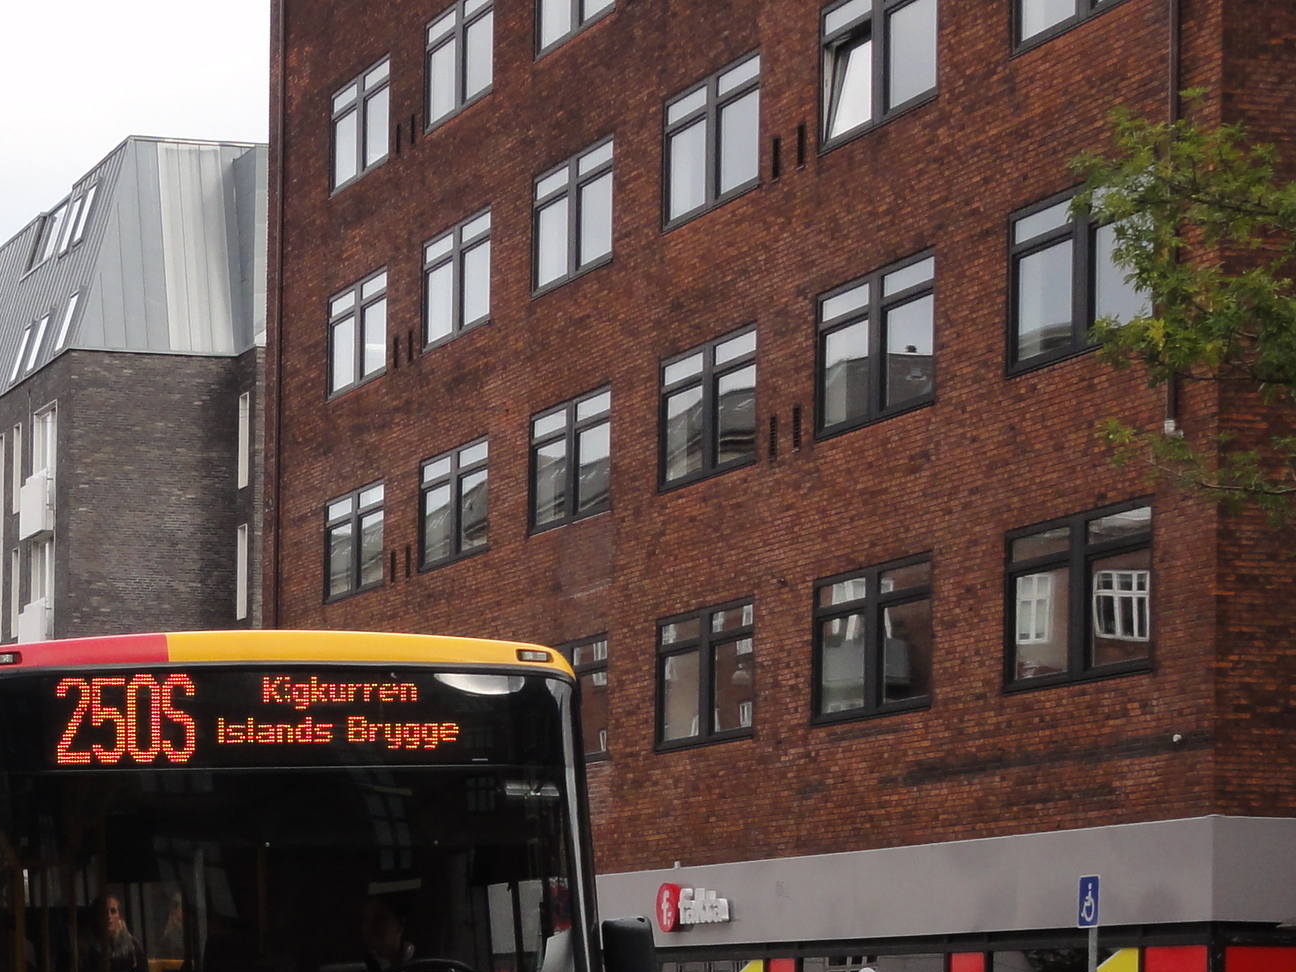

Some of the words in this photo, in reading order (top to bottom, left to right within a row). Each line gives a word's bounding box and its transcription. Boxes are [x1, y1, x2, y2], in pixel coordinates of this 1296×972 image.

[263, 676, 418, 709] Kigkurren
[56, 673, 196, 764] 250S
[217, 716, 333, 744] Islands
[347, 716, 460, 749] Brygge
